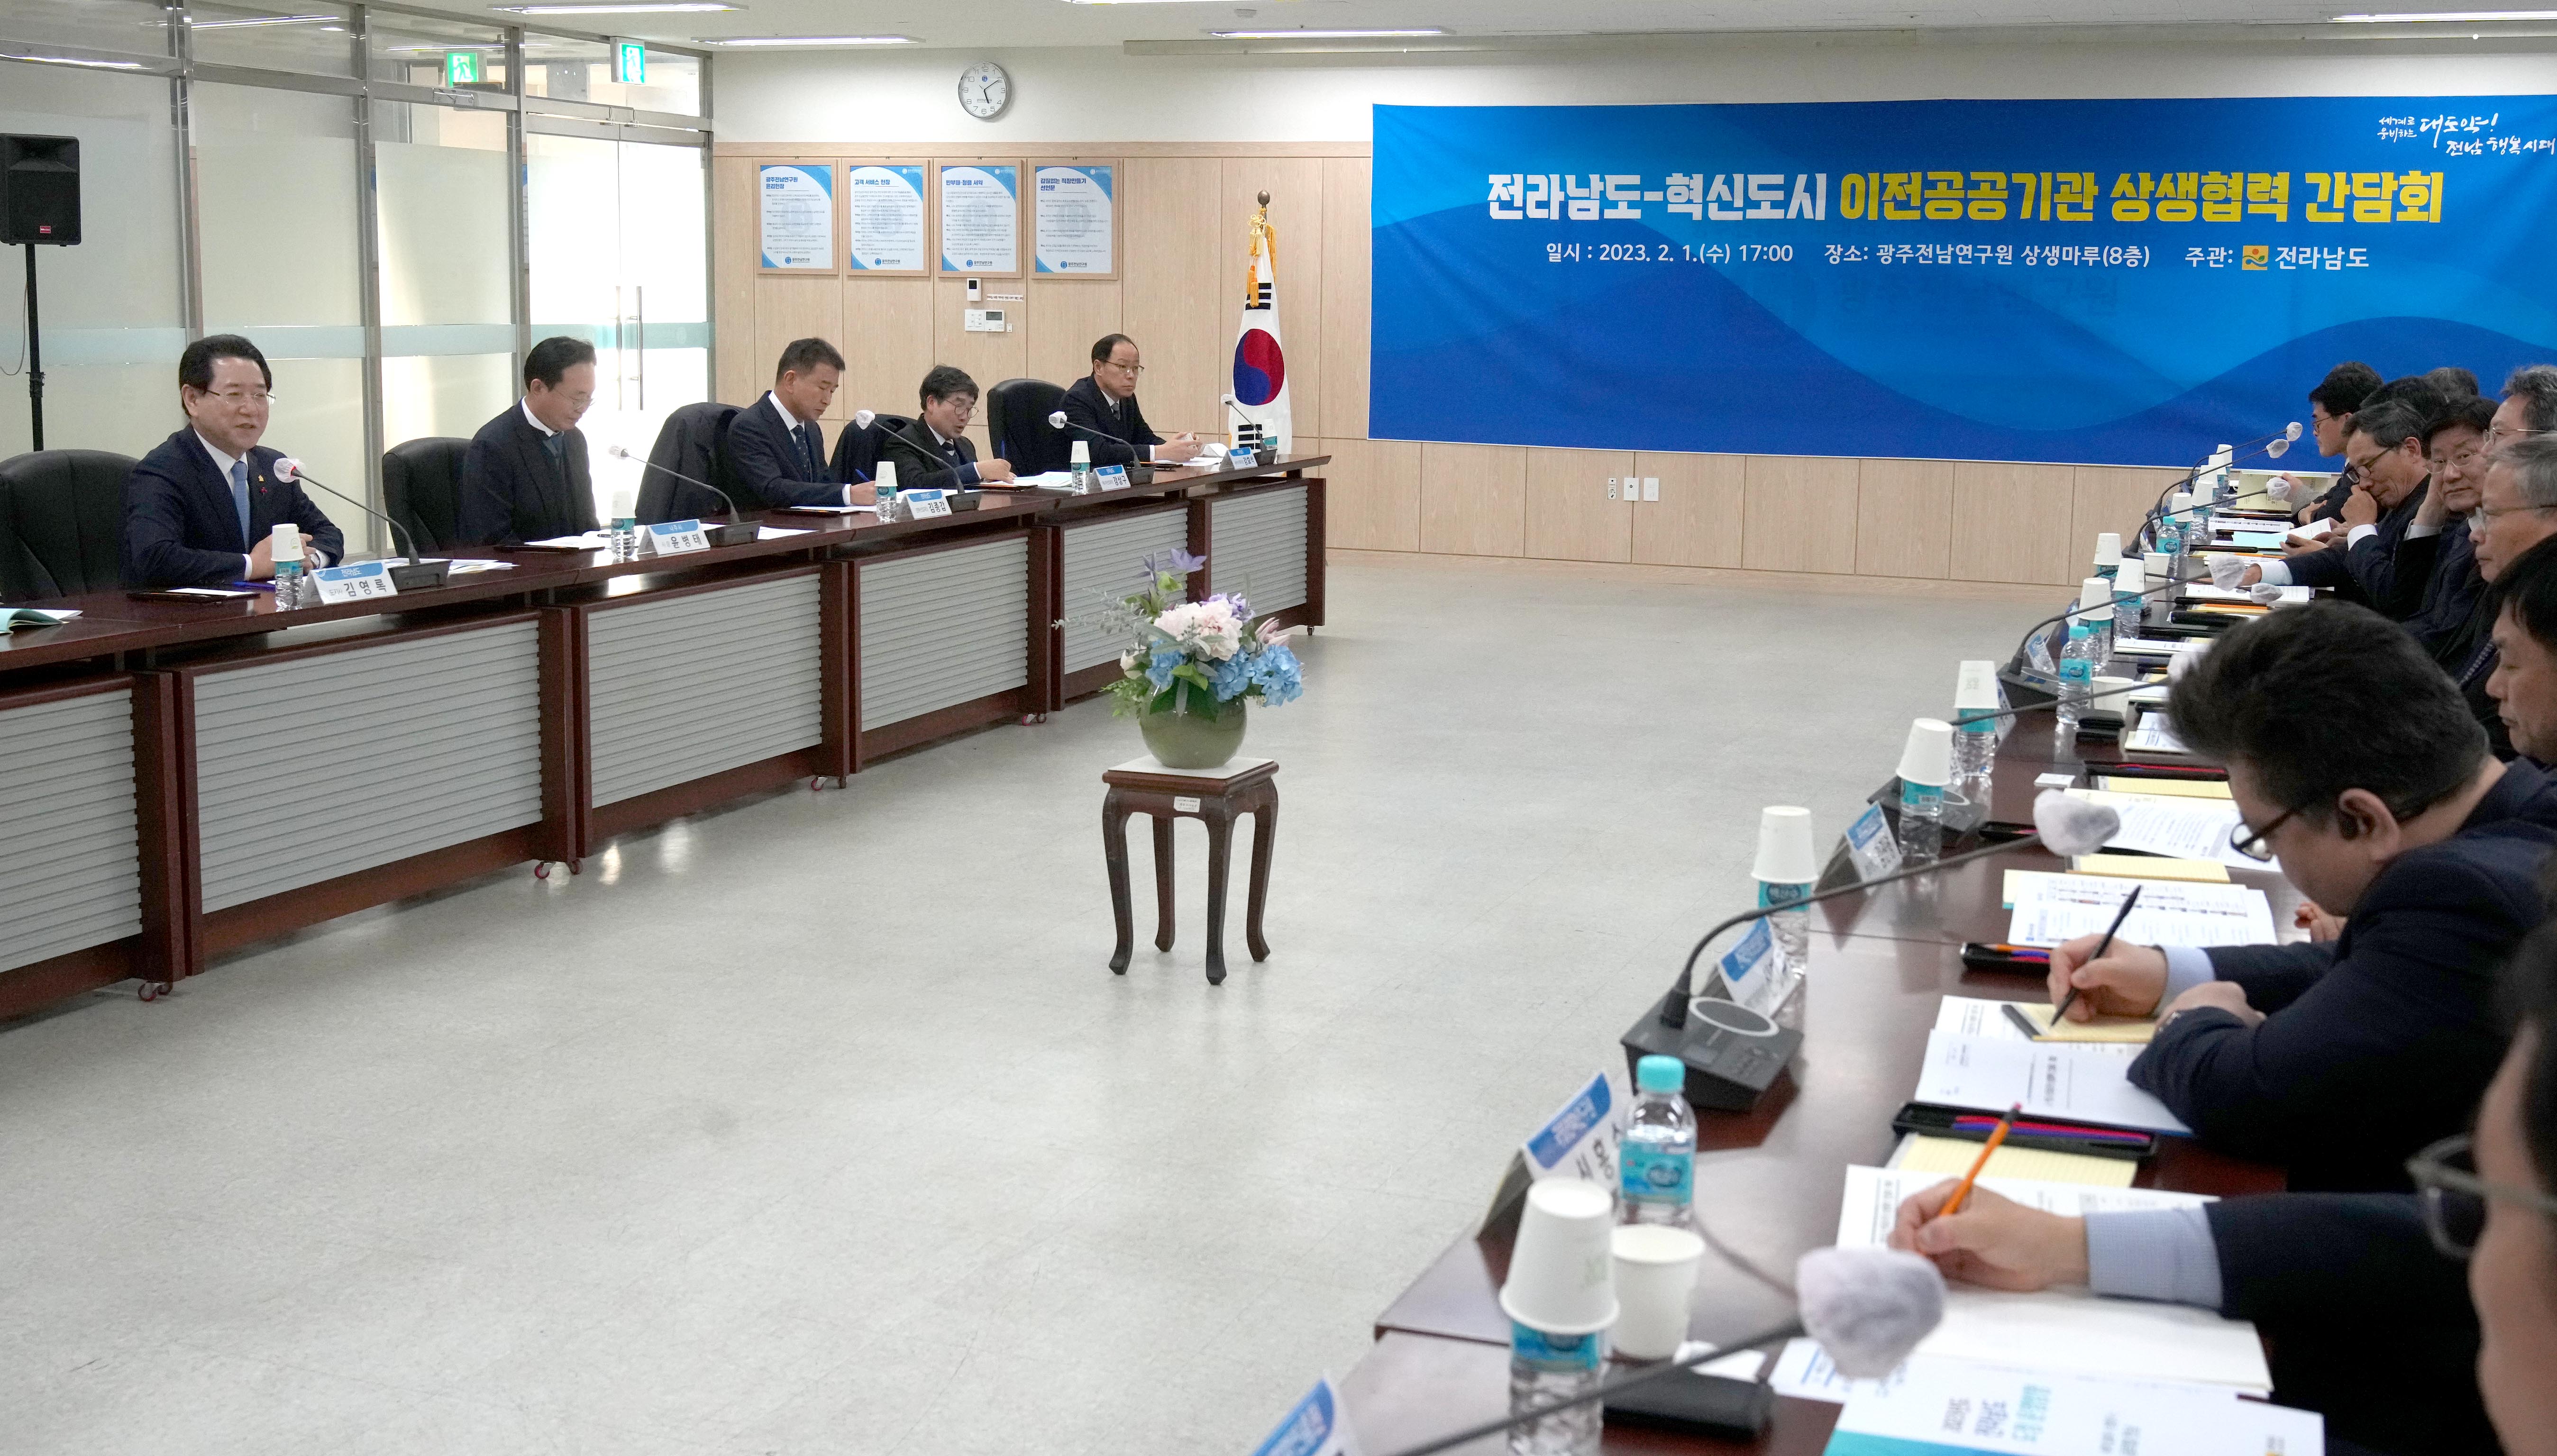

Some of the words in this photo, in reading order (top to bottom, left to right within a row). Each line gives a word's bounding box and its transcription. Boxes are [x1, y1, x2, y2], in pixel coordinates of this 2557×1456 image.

[2379, 116, 2415, 126] 세계로
[2377, 127, 2417, 143] 웅비하는
[2420, 113, 2499, 148] 대도약!
[2446, 138, 2483, 156] 전남
[1487, 173, 1827, 220] 전라남도-혁신도시
[1840, 171, 2099, 221] 이전공공기관
[2110, 171, 2289, 222] 상생협력
[2305, 170, 2444, 223] 간담회
[1546, 243, 1580, 263] 일시
[1599, 244, 1651, 262] 2023.
[1658, 244, 1674, 262] 2.
[1682, 244, 1731, 264] 1.(수)
[1739, 244, 1793, 262] 17:00
[1824, 244, 1869, 265] 장소:
[1876, 244, 2013, 265] 광주전남연구원
[2021, 245, 2150, 268] 상생마루(8층)
[2185, 246, 2234, 268] 주관:
[2275, 246, 2369, 271] 전라남도
[1113, 476, 1126, 485] 강상구
[928, 501, 946, 513] 김종갑
[341, 568, 363, 577] 전라남도
